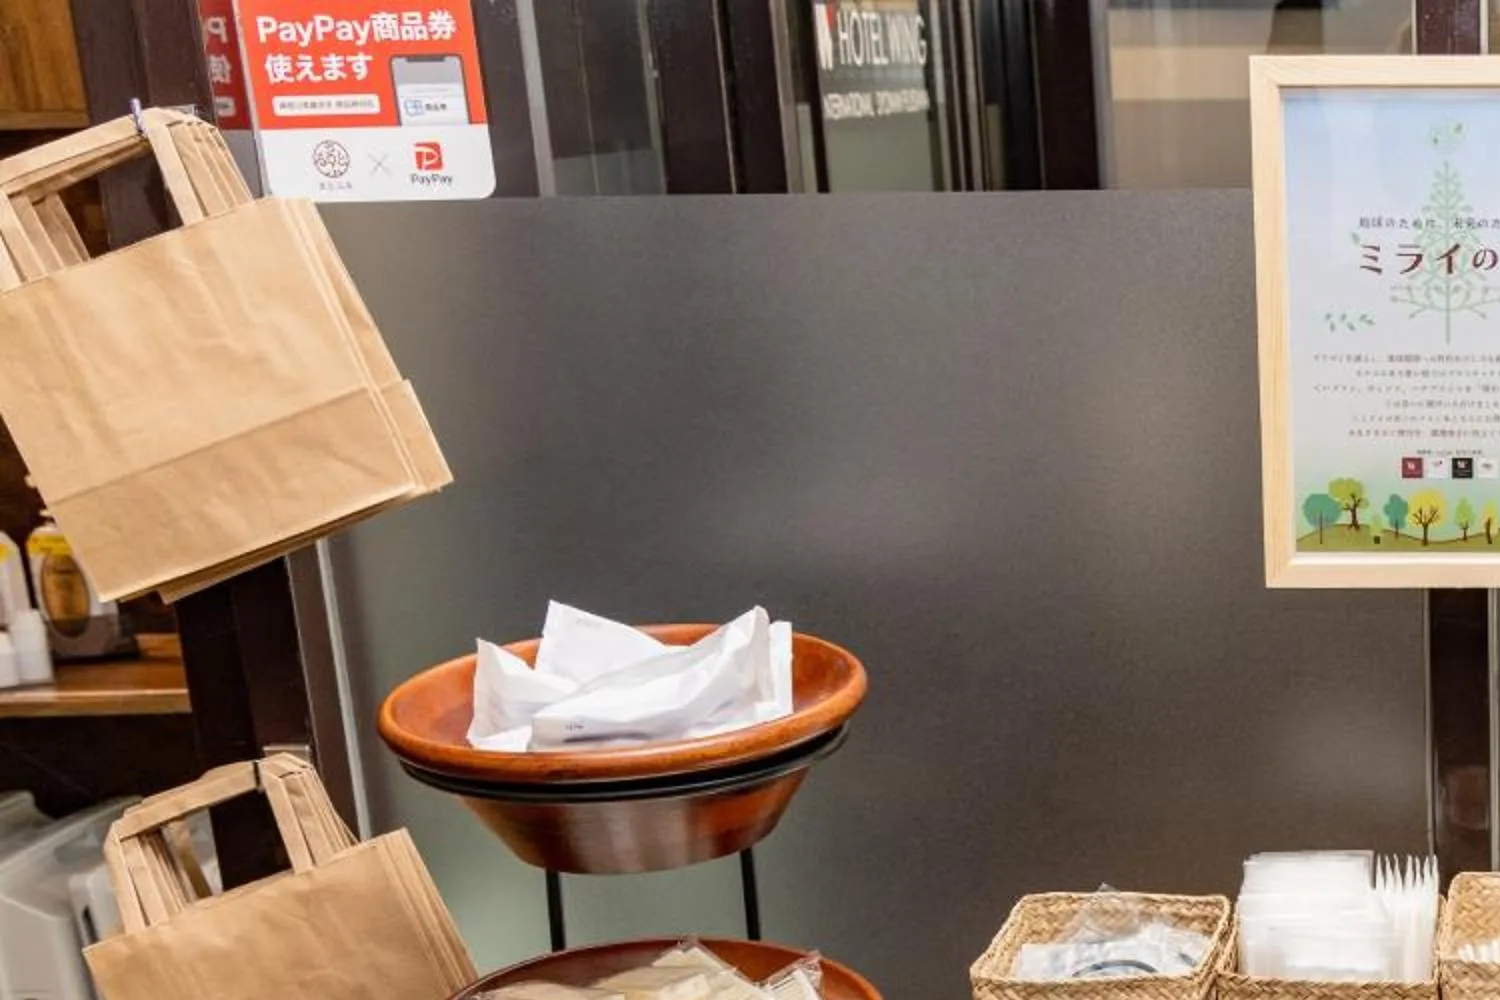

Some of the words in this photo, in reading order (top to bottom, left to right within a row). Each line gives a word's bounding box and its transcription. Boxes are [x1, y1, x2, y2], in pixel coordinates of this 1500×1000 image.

[255, 10, 457, 46] PayPay商品券
[837, 11, 889, 66] HOTEL
[889, 14, 928, 66] WING
[264, 53, 373, 83] 使えます
[410, 172, 454, 189] PayPay
